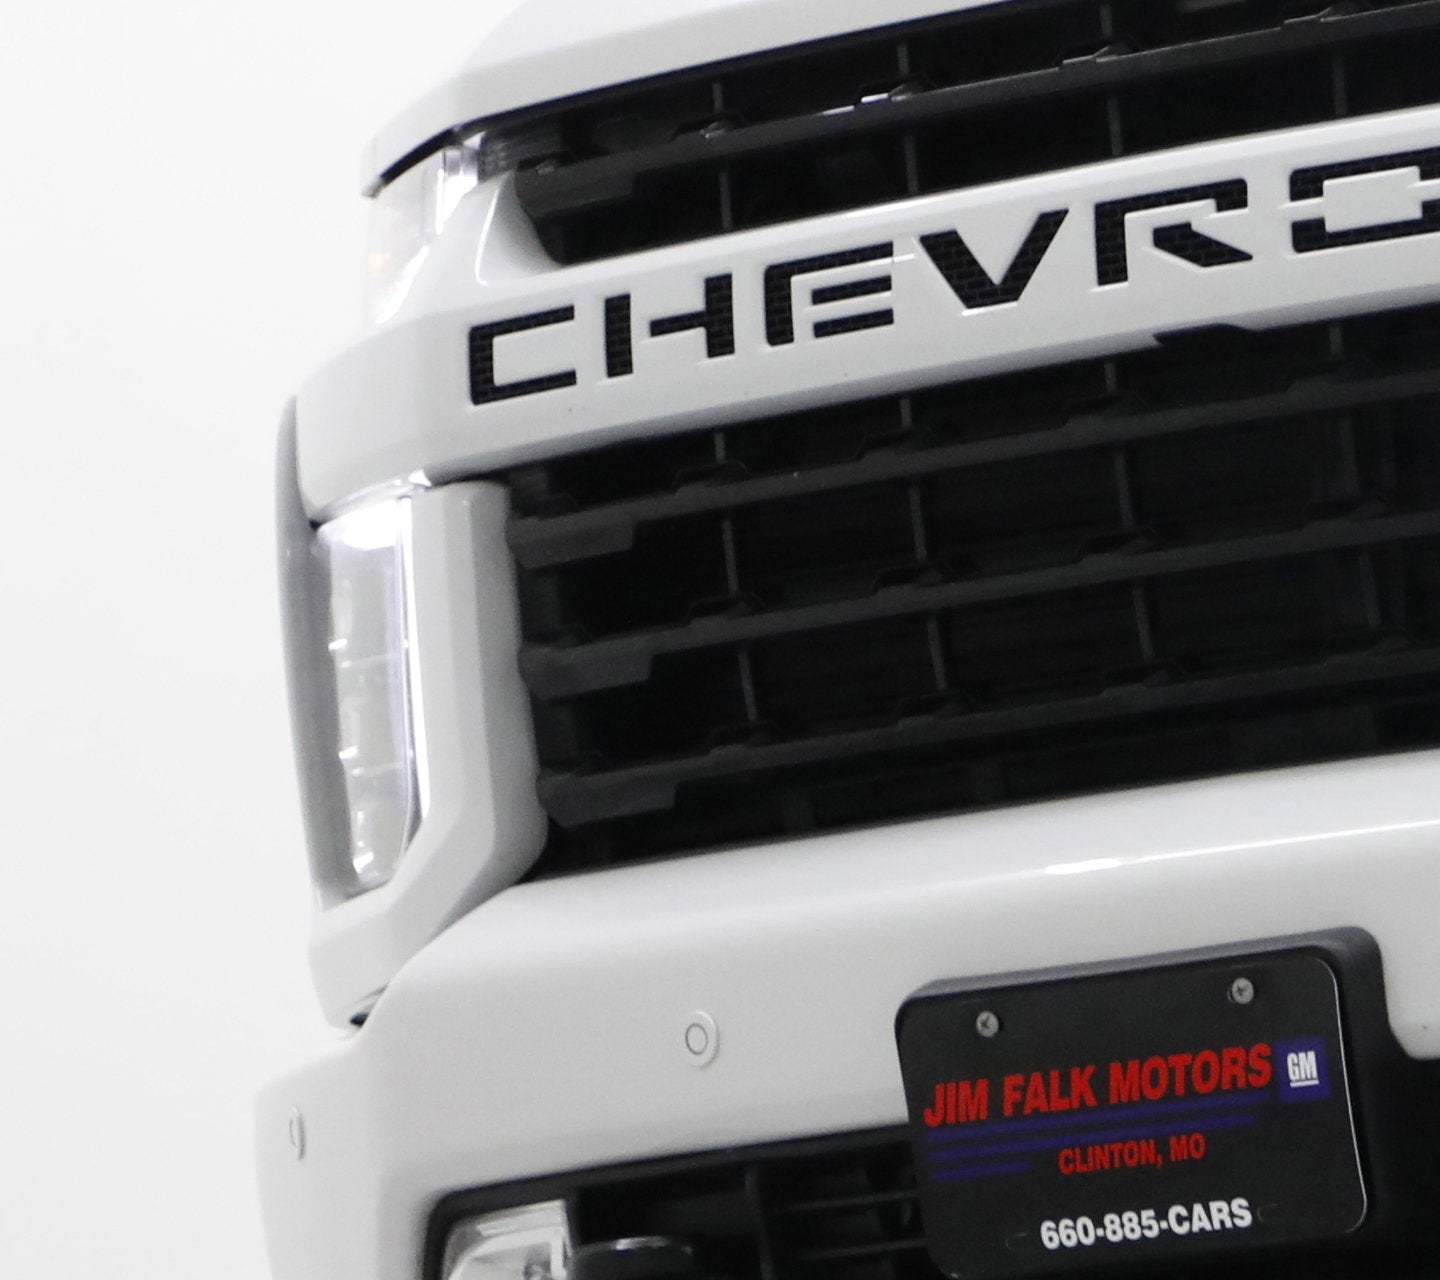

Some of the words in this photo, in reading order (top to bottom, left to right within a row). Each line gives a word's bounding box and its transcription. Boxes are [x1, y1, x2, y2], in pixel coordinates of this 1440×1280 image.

[924, 1077, 989, 1127] JIM
[1003, 1066, 1098, 1117] FALK
[1109, 1042, 1273, 1104] MOTORS
[1286, 1051, 1319, 1088] GM
[1058, 1139, 1163, 1176] CLINTON,
[1170, 1132, 1207, 1164] MO
[1040, 1196, 1253, 1251] 660-885-CARS
